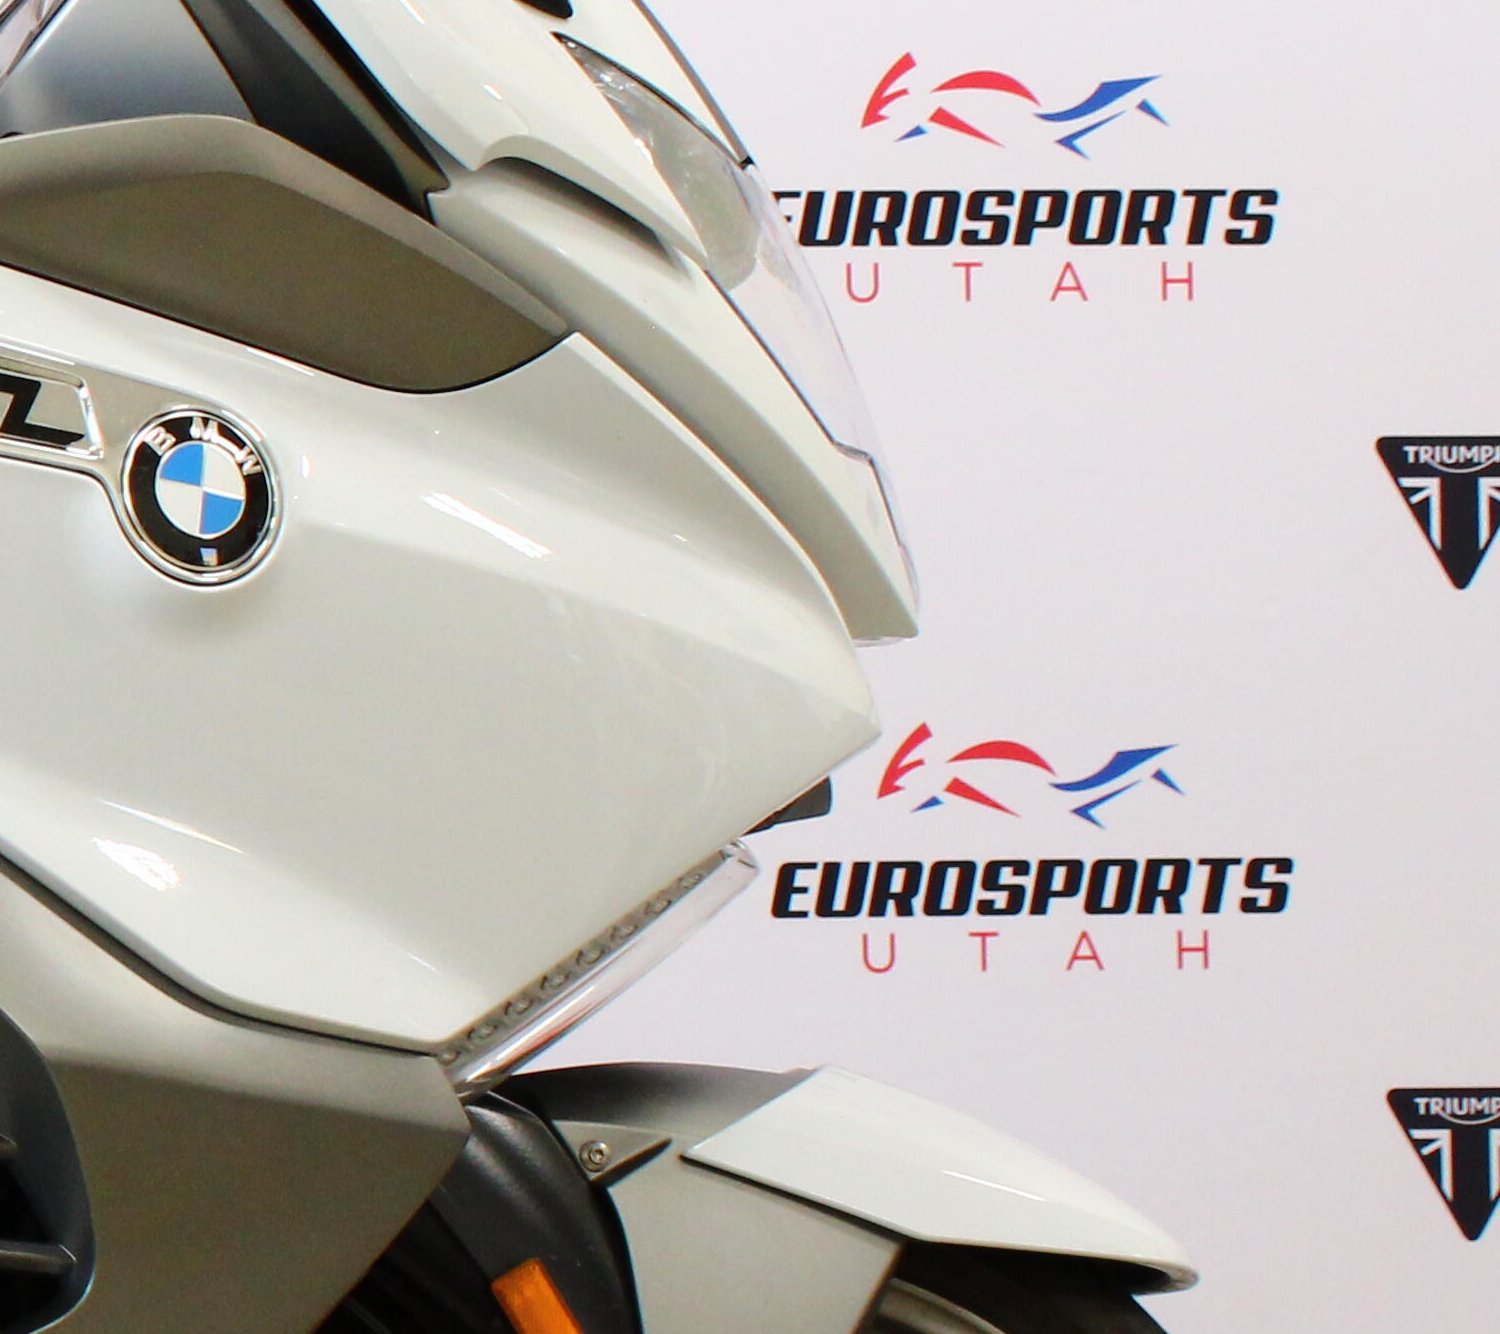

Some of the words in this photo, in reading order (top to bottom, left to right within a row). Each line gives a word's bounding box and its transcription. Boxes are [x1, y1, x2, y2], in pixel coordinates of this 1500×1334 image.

[845, 260, 1195, 304] UTAH
[144, 416, 261, 476] BMW
[770, 856, 1294, 920] EUROSPORTS
[860, 929, 1212, 975] UTAH
[1412, 1096, 1500, 1116] TRIUMP
